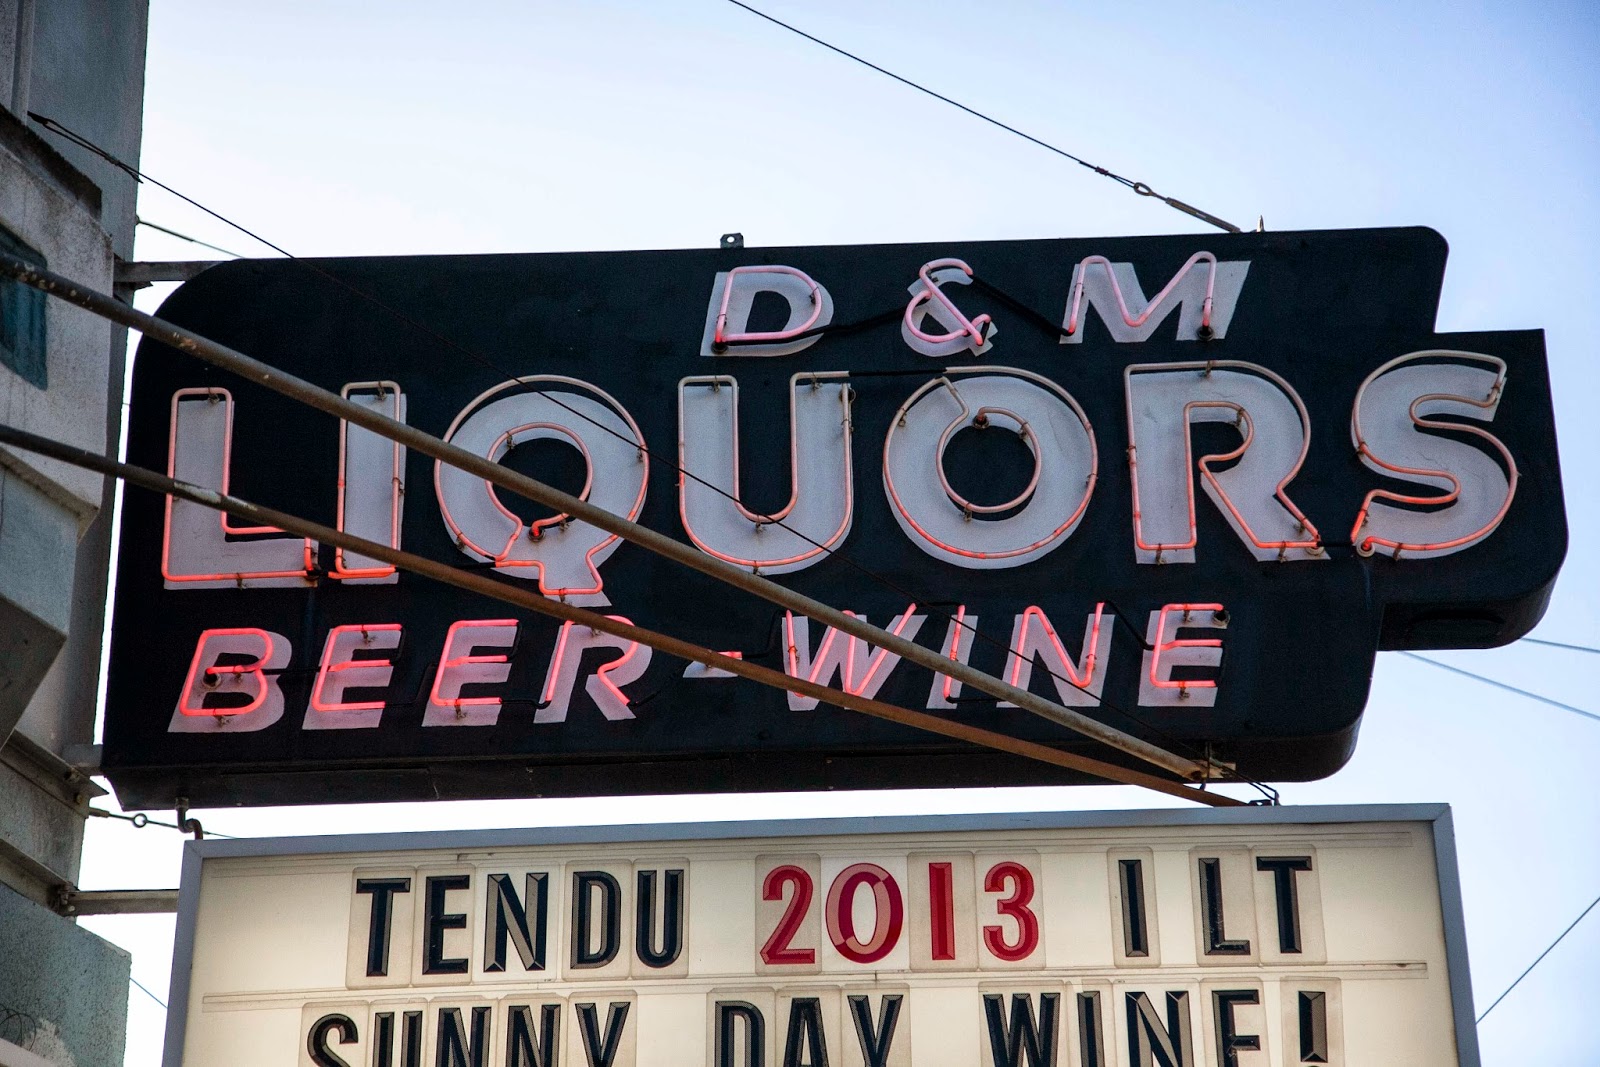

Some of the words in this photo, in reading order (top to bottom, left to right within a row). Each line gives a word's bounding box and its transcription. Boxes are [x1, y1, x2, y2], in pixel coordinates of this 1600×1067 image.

[701, 265, 835, 358] D
[901, 258, 997, 358] &
[1059, 251, 1252, 345] M
[163, 350, 1519, 608] LIQUORS
[167, 614, 653, 733] BEER
[780, 601, 1230, 713] WINE
[355, 869, 684, 977] TENDU
[759, 862, 1039, 965] 2013
[306, 1001, 632, 1067] SUNNY
[714, 995, 904, 1067] DAY
